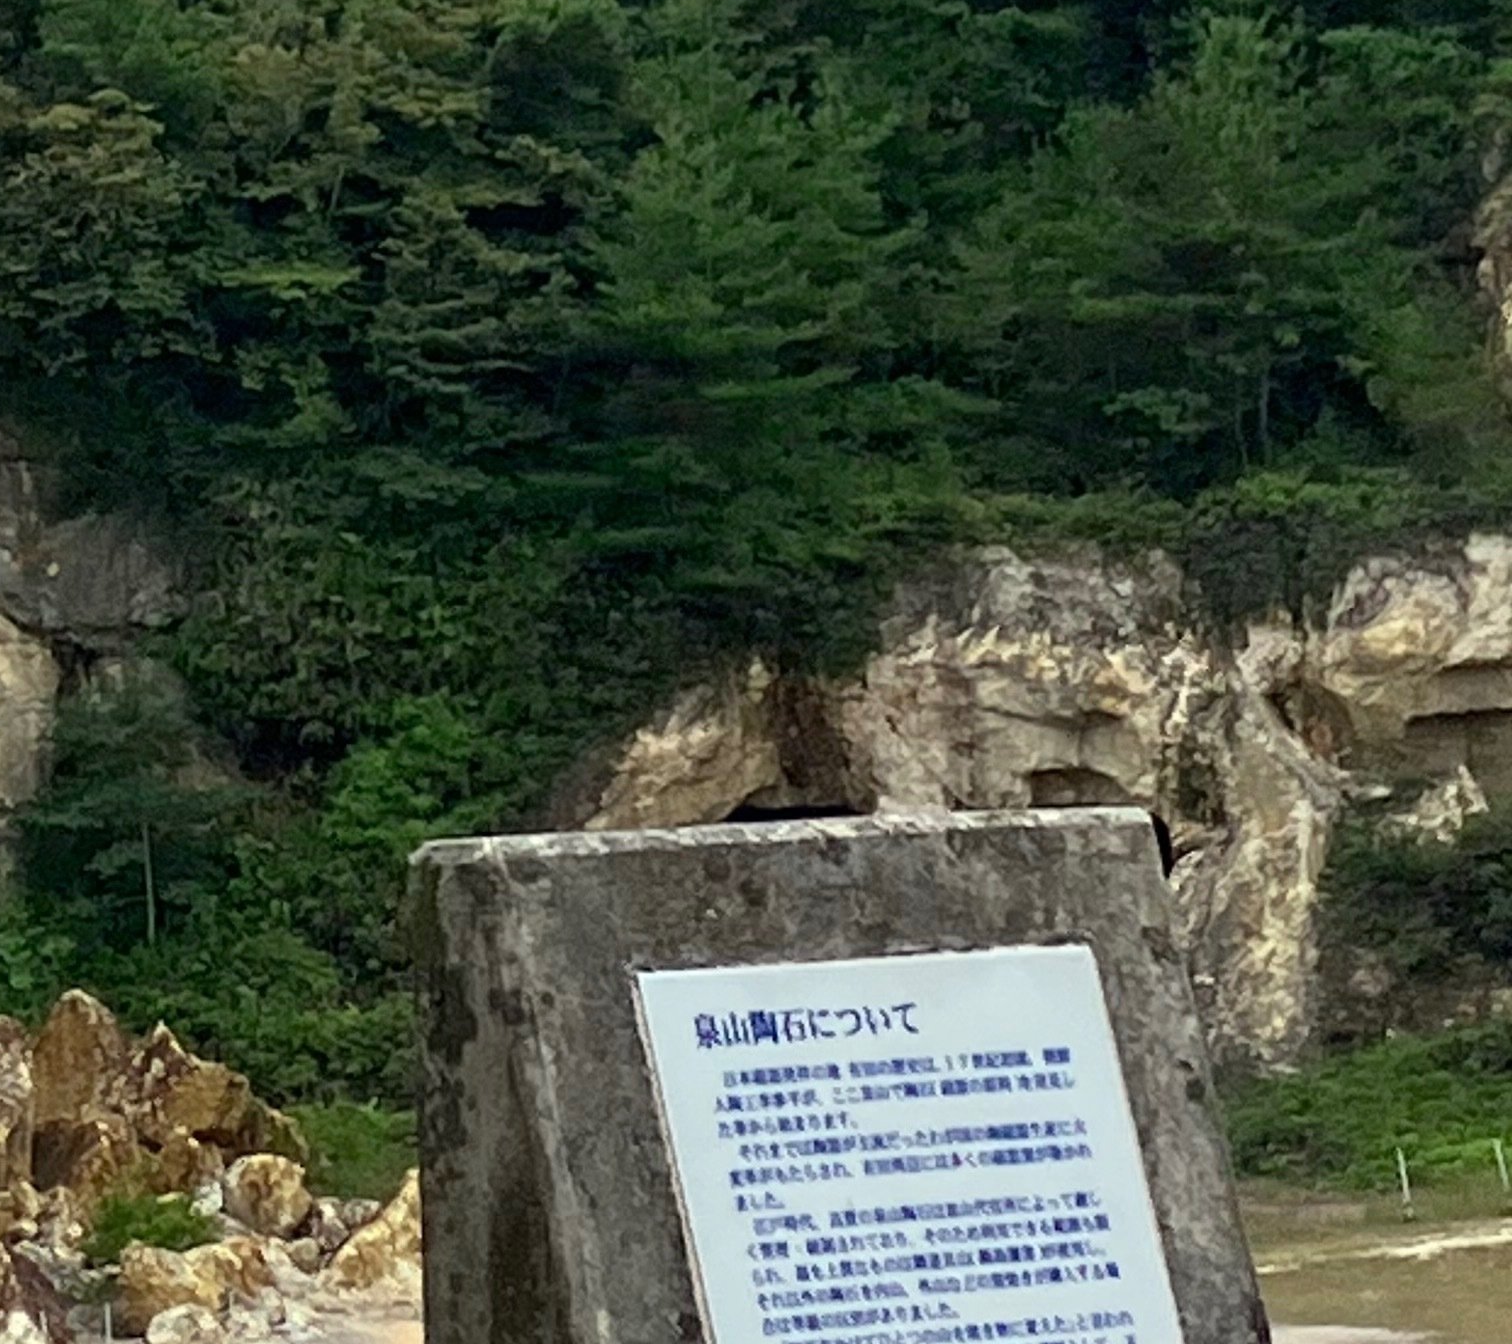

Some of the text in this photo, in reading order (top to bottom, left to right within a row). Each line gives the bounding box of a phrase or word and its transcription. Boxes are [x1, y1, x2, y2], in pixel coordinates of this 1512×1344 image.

[693, 1001, 919, 1049] 泉山陶石について
